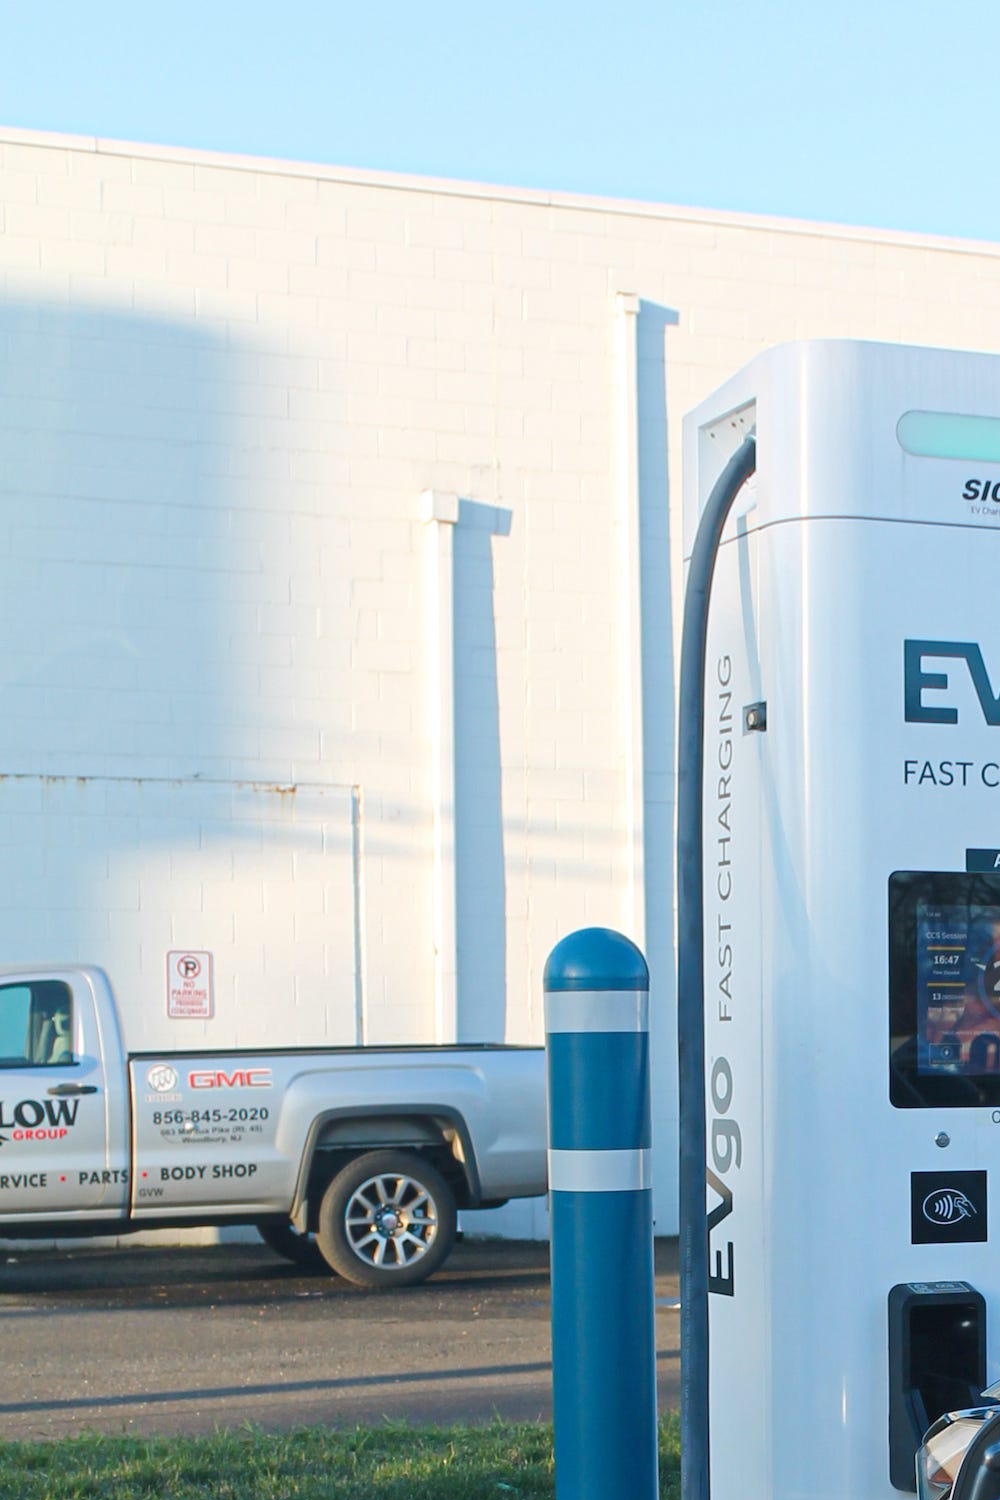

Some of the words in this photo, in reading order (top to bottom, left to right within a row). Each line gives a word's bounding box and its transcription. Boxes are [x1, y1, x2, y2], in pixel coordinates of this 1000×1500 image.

[717, 654, 733, 901] CHARGING
[904, 760, 974, 785] FAST
[718, 913, 732, 1021] FAST
[933, 955, 960, 965] 16:47
[188, 1068, 272, 1089] GMC
[152, 1107, 270, 1125] 856-845-2020
[12, 1128, 67, 1141] GROUP
[79, 1169, 129, 1185] PARTS
[160, 1166, 206, 1181] BODY
[212, 1163, 257, 1179] SHOP
[706, 1056, 742, 1297] EVgo
[138, 1187, 164, 1198] GVW
